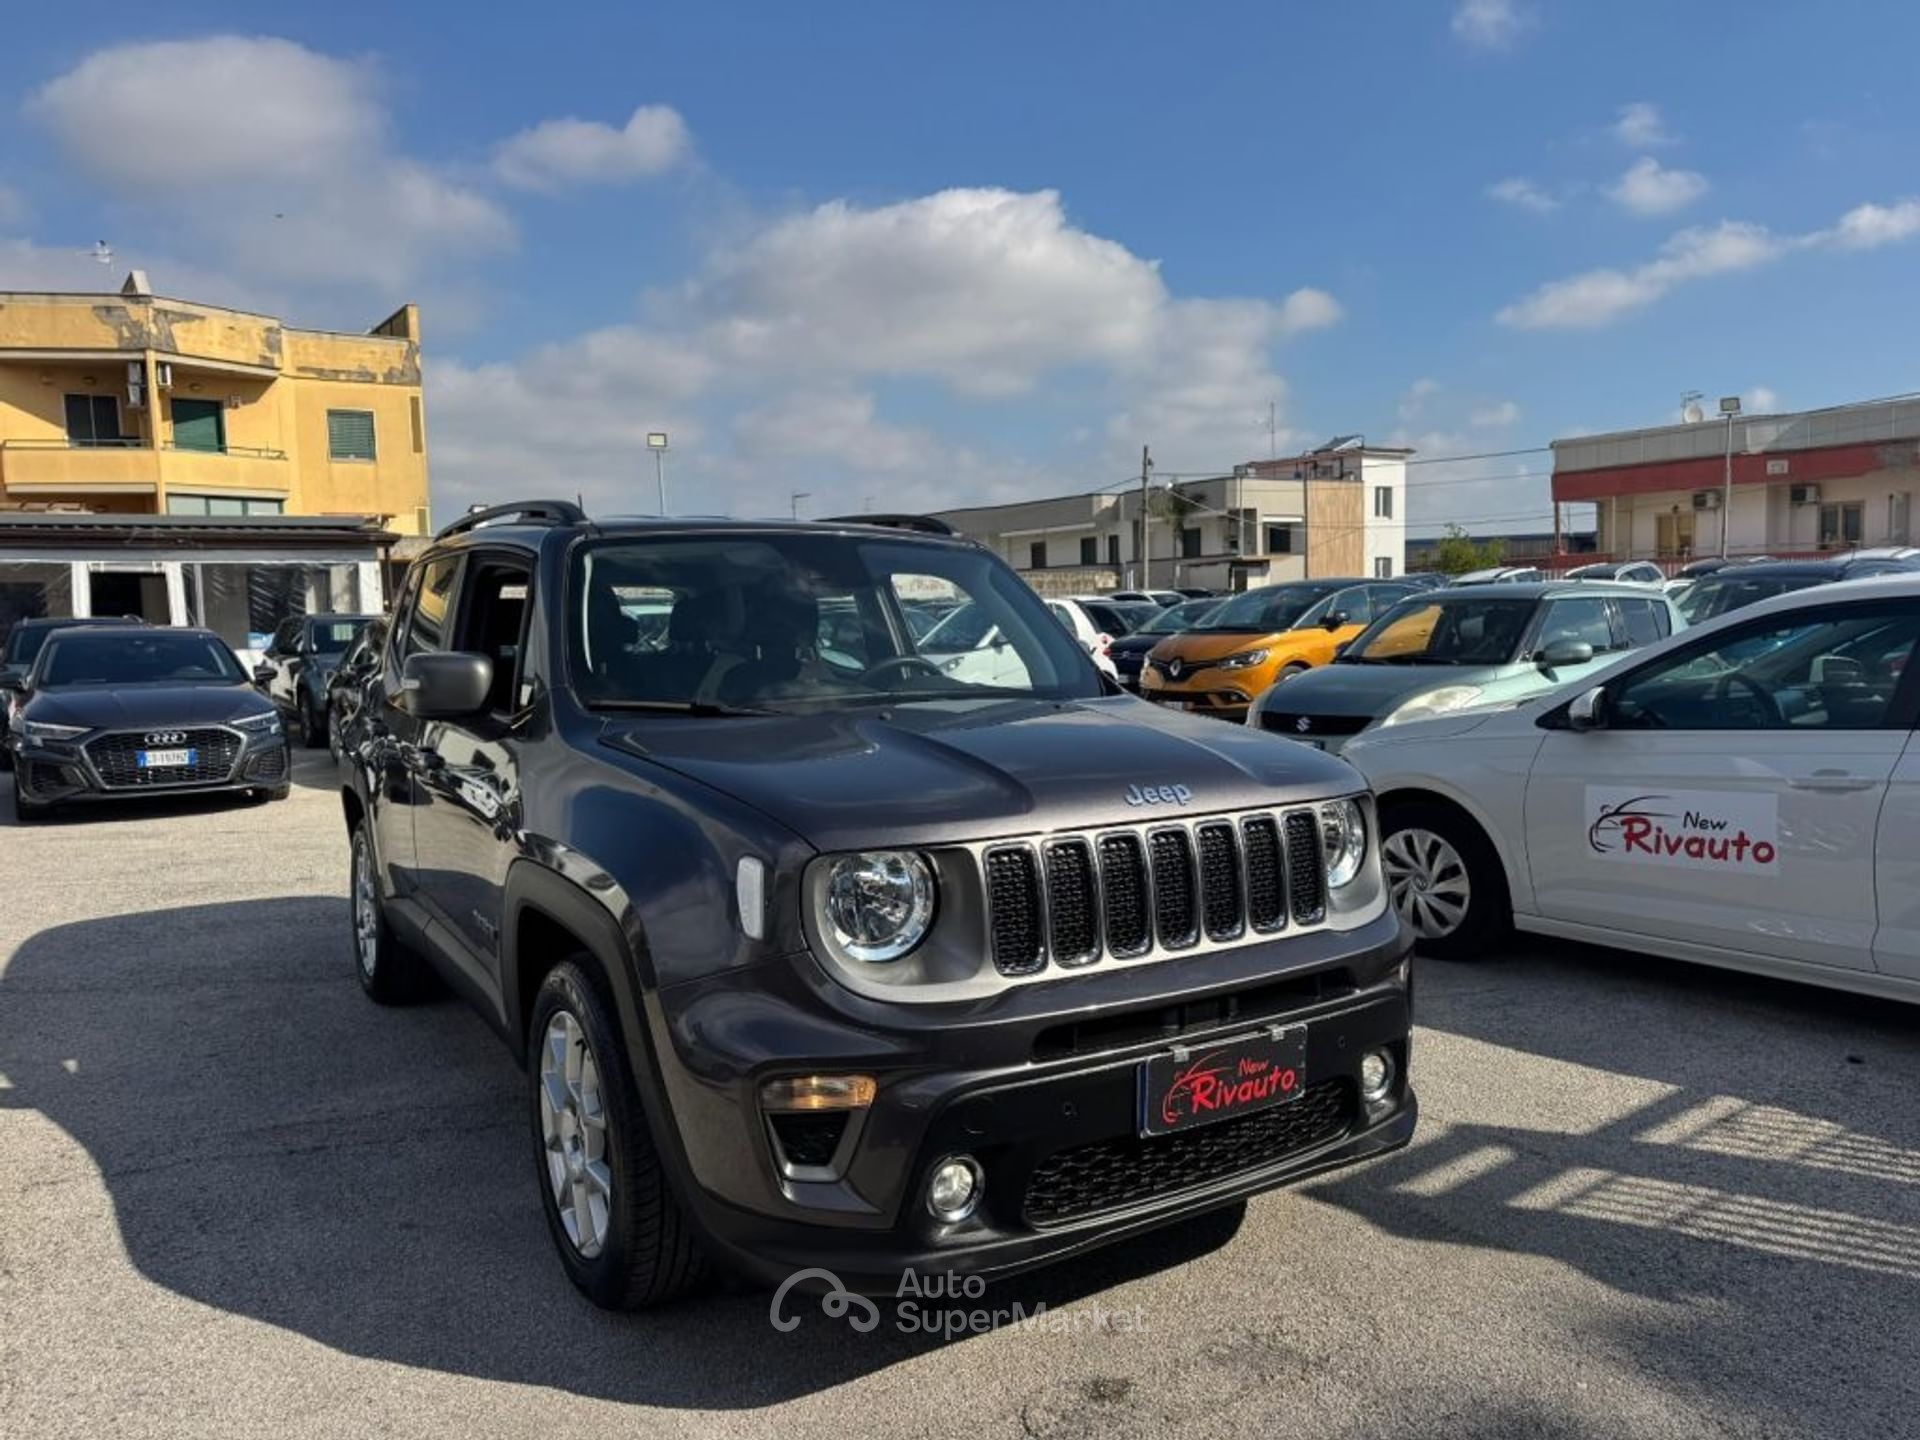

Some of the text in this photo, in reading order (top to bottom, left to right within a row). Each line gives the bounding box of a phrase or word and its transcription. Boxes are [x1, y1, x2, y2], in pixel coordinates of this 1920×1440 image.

[1124, 784, 1192, 806] Jeep
[1682, 811, 1727, 831] New
[1620, 816, 1775, 863] Rivauto
[1238, 1058, 1270, 1076] New
[1191, 1065, 1296, 1114] Rivauto
